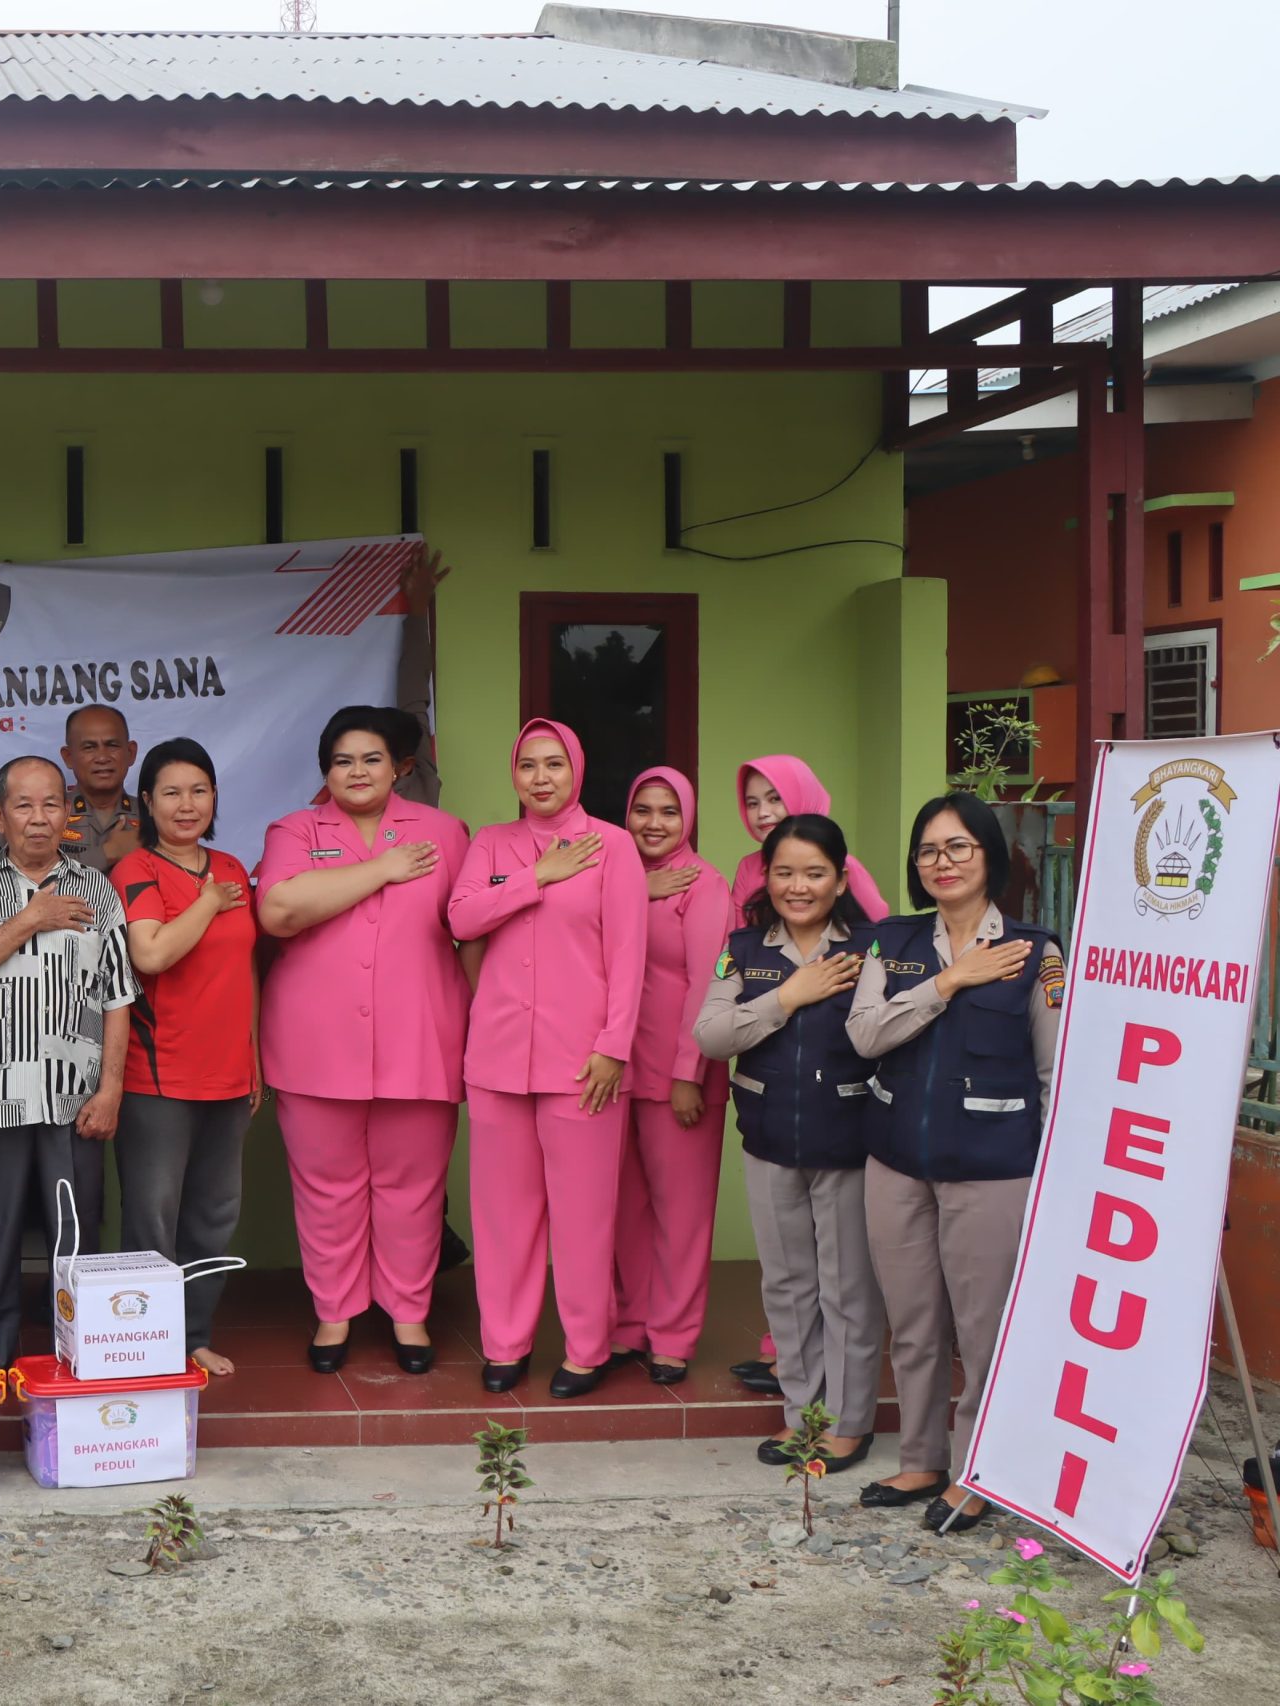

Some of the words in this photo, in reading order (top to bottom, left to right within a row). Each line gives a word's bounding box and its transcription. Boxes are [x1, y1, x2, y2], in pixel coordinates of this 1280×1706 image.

[131, 655, 226, 701] SANA
[1153, 761, 1219, 783] BHAYANGKARI
[1142, 890, 1169, 911] KEMALA
[1169, 893, 1199, 911] HIKMAH
[1084, 945, 1249, 1004] BHAYANGKARI
[1053, 1021, 1183, 1519] PEDULI
[84, 1330, 169, 1345] BHAYANGKARI
[104, 1351, 145, 1363] PEDULI
[74, 1437, 159, 1455] BHAYANGKARI
[94, 1459, 136, 1472] PEDULI
